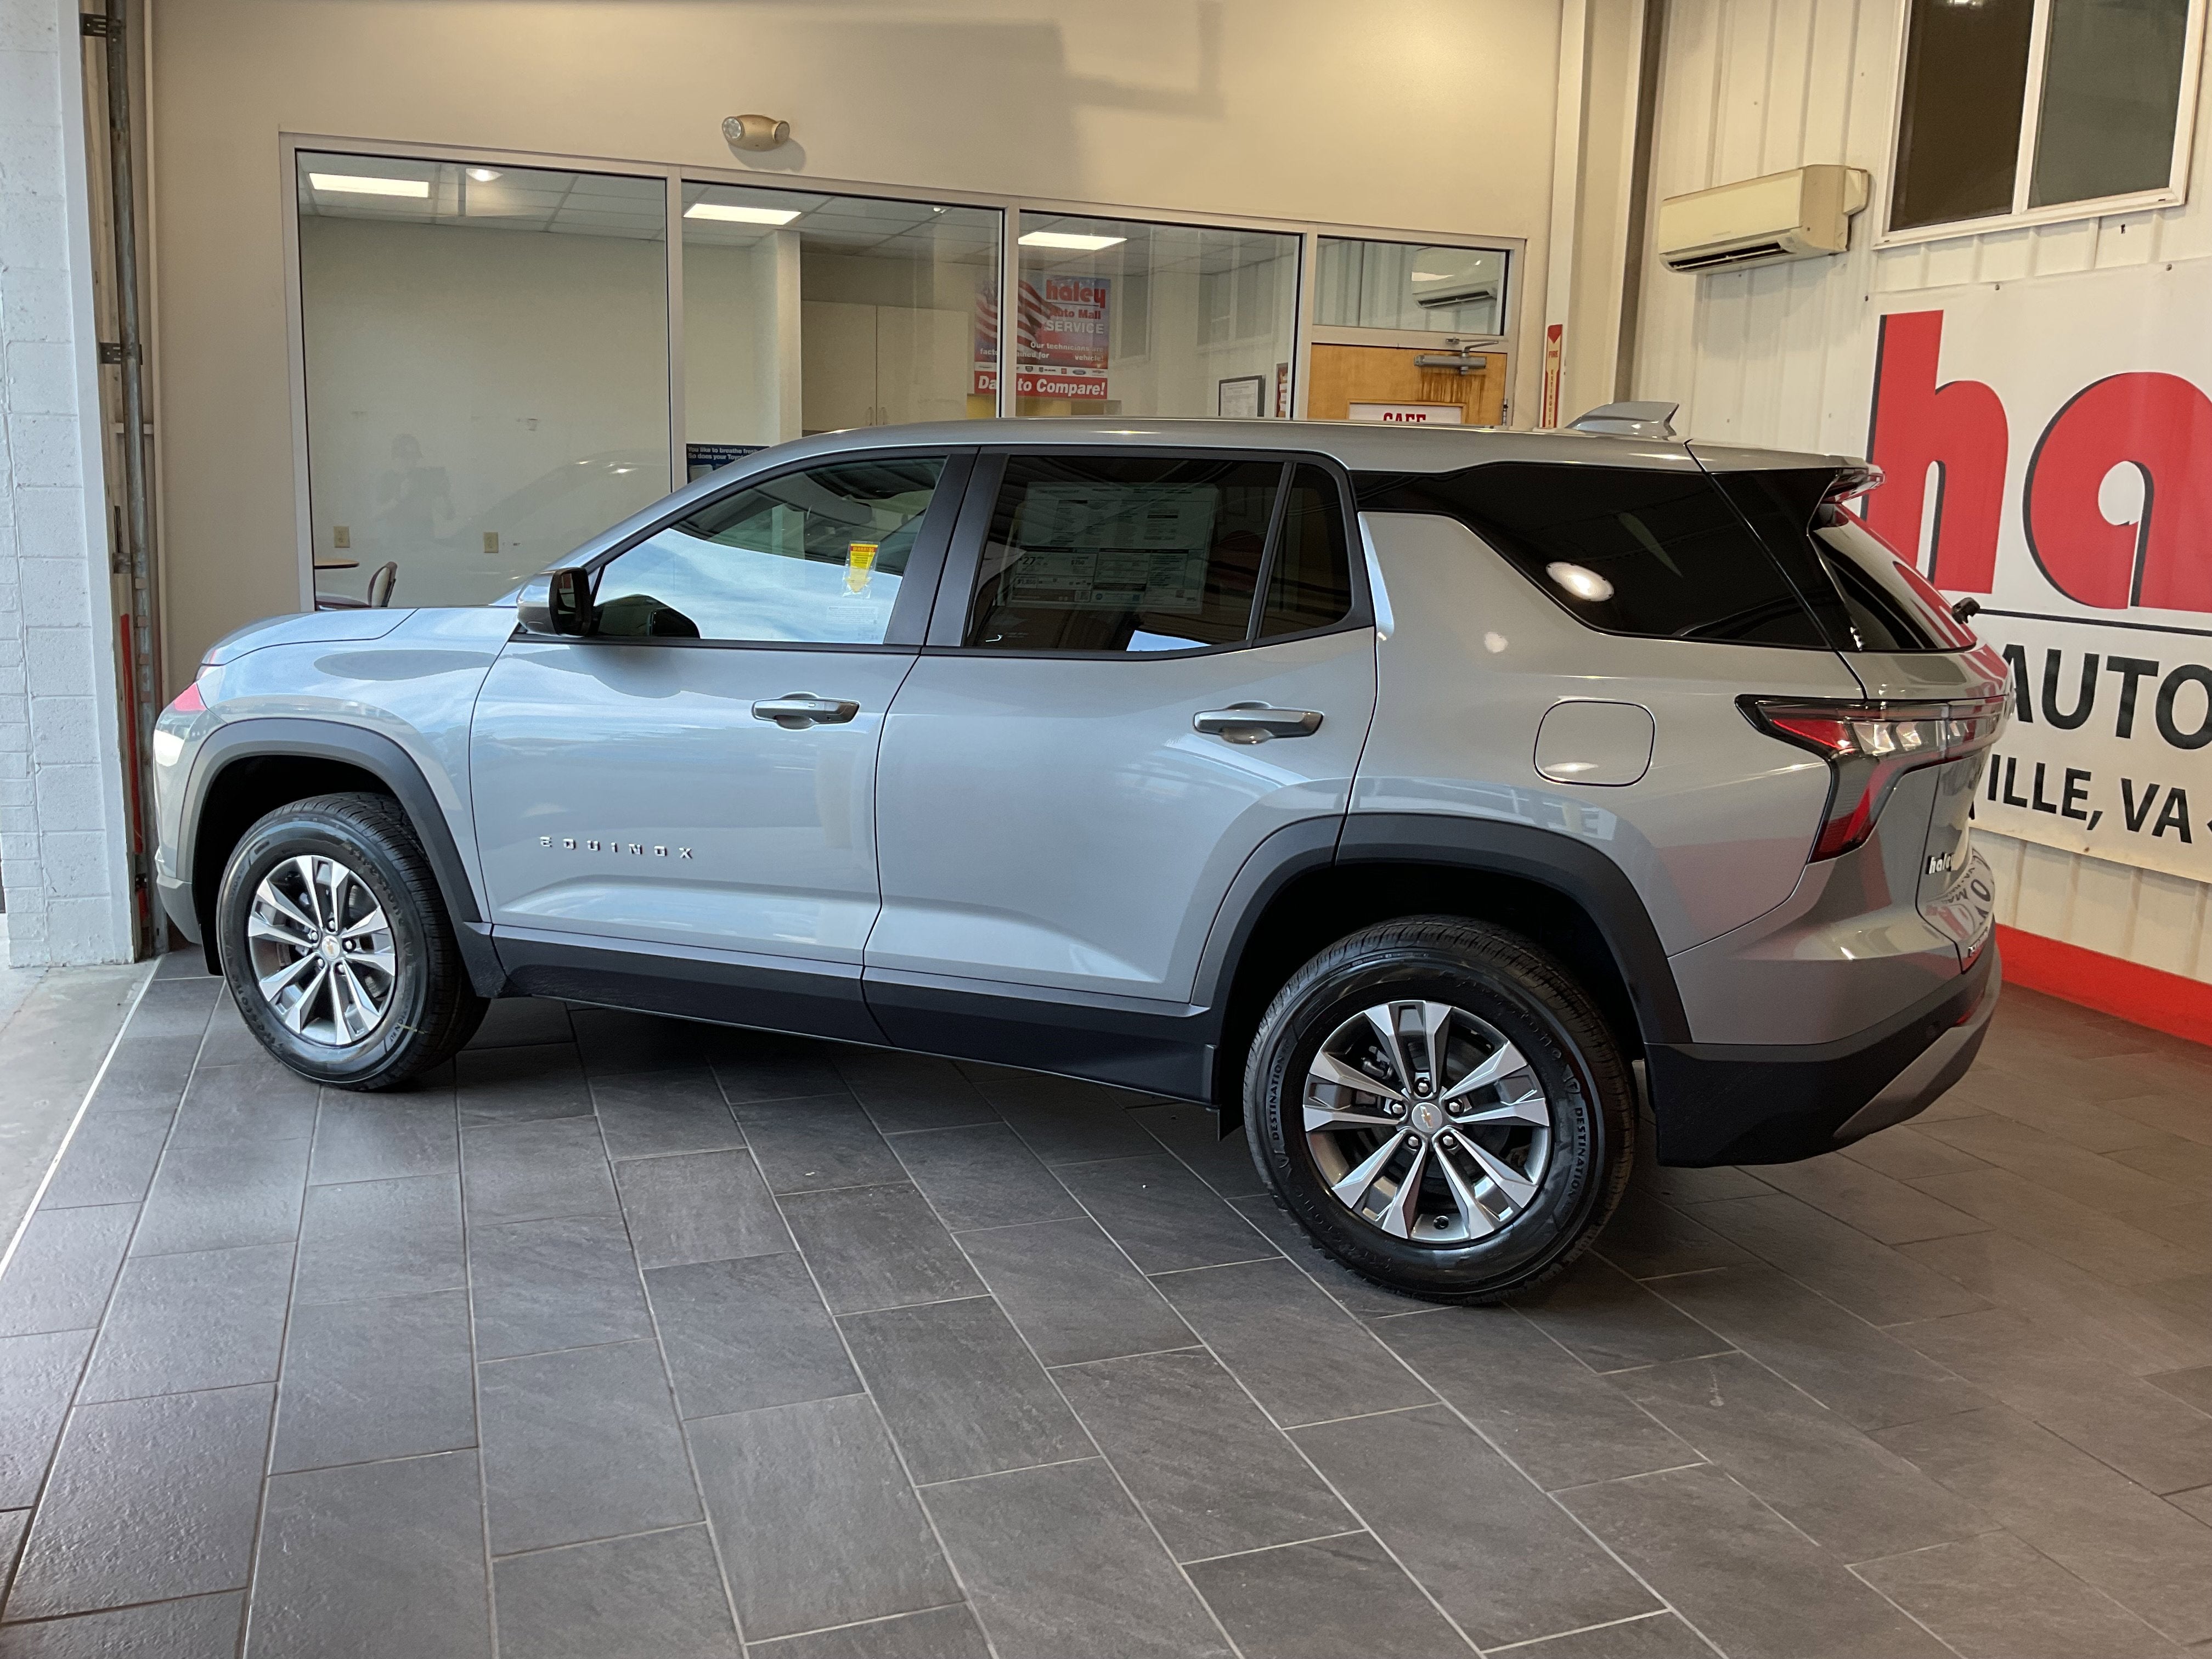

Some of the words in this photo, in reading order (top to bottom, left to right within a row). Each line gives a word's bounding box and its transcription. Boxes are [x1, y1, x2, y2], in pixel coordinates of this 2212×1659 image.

[1046, 279, 1106, 308] haley
[1050, 307, 1075, 318] Auto
[1078, 309, 1101, 319] Mall
[1045, 320, 1104, 334] SERVICE
[1047, 343, 1089, 352] technicians
[1549, 350, 1559, 358] FIRE
[1017, 379, 1032, 391] to
[1036, 379, 1105, 397] Compare!
[2002, 644, 2212, 750] AUTO
[2120, 777, 2193, 844] VA
[540, 836, 693, 860] EQUINOX
